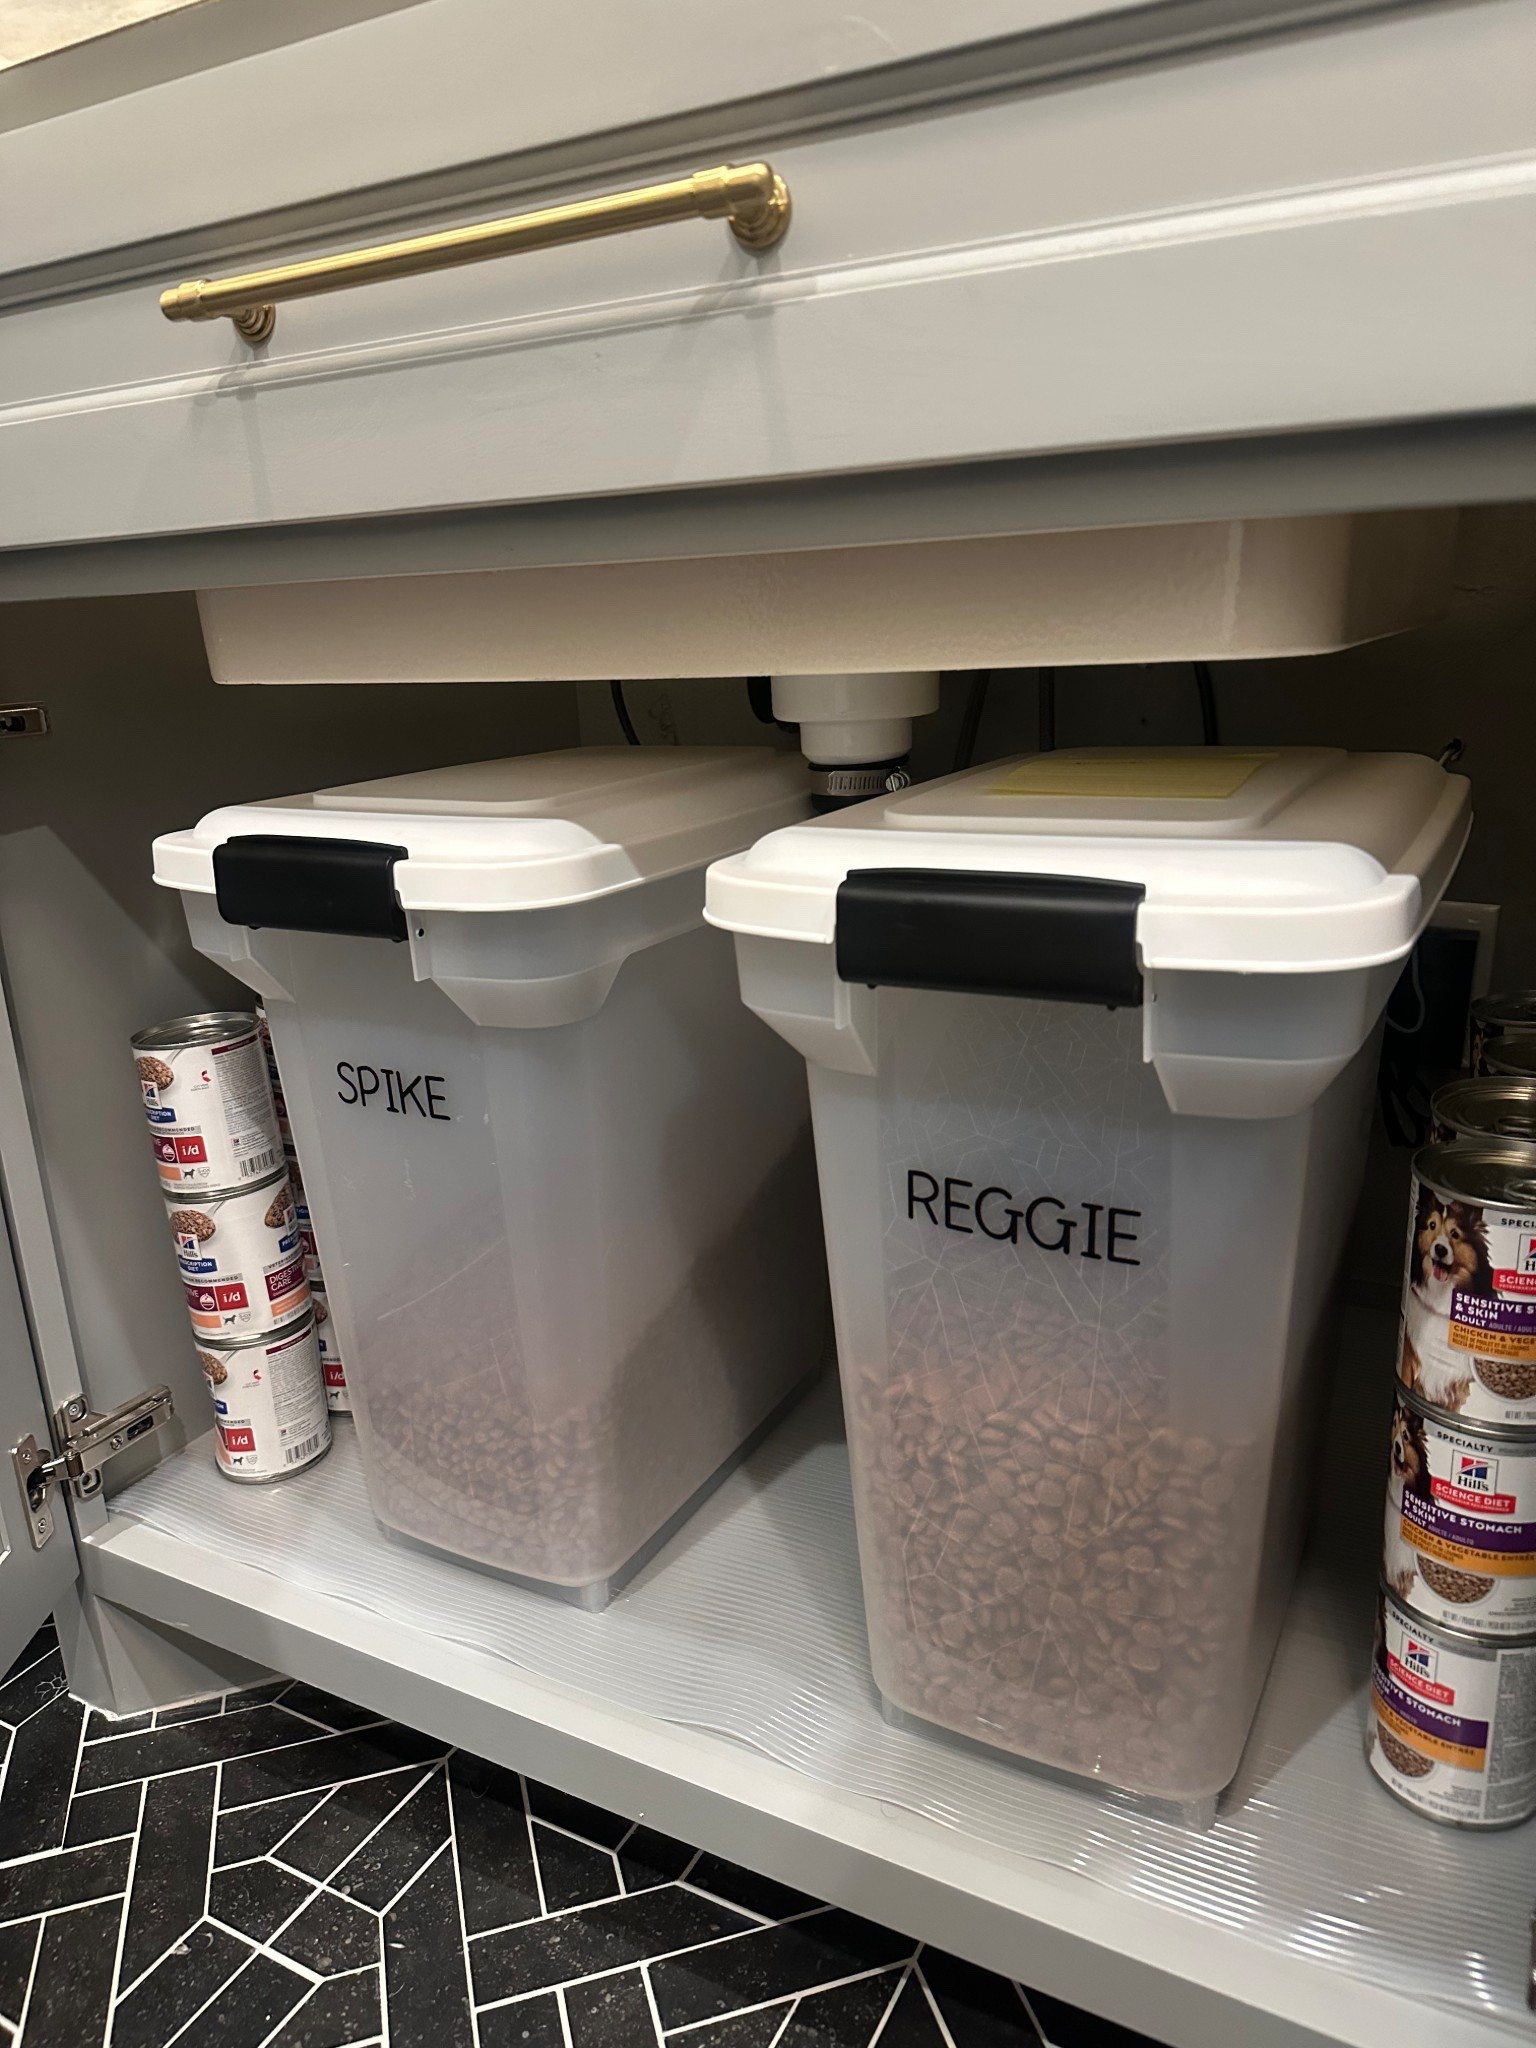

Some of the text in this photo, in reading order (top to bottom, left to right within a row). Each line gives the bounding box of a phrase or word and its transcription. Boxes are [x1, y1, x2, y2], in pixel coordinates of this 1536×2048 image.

[337, 1062, 451, 1121] SPIKE
[182, 1145, 200, 1156] i/d
[907, 1169, 1142, 1266] REGGIE
[1501, 1217, 1536, 1229] SPECI
[269, 1258, 303, 1285] DIGESTIVE
[1499, 1275, 1536, 1286] SCIEN
[271, 1277, 293, 1292] CARE
[223, 1291, 241, 1303] i/d
[1456, 1292, 1523, 1314] SENSITIVE
[1455, 1302, 1499, 1320] & SKIN
[1454, 1313, 1487, 1327] ADULT
[1488, 1322, 1513, 1332] ADULTE
[1453, 1324, 1497, 1341] CHICKEN
[1499, 1334, 1507, 1342] &
[232, 1435, 248, 1446] i/d
[1437, 1431, 1494, 1453] SPECIALTY
[1457, 1475, 1489, 1493] Hill's
[1435, 1482, 1511, 1508] SCIENCE DIET
[1403, 1509, 1427, 1528] ADULT
[1404, 1489, 1523, 1535] SENSITIVE STOMACH
[1412, 1504, 1436, 1524] SKIN
[1402, 1518, 1435, 1543] CHICKEN
[1444, 1540, 1499, 1562] VEGETABLE
[1391, 1611, 1434, 1644] SPECIALTY
[1404, 1658, 1431, 1679] Hill's
[1388, 1659, 1450, 1699] SCIENCE DIET
[1406, 1697, 1462, 1728] STOMACH
